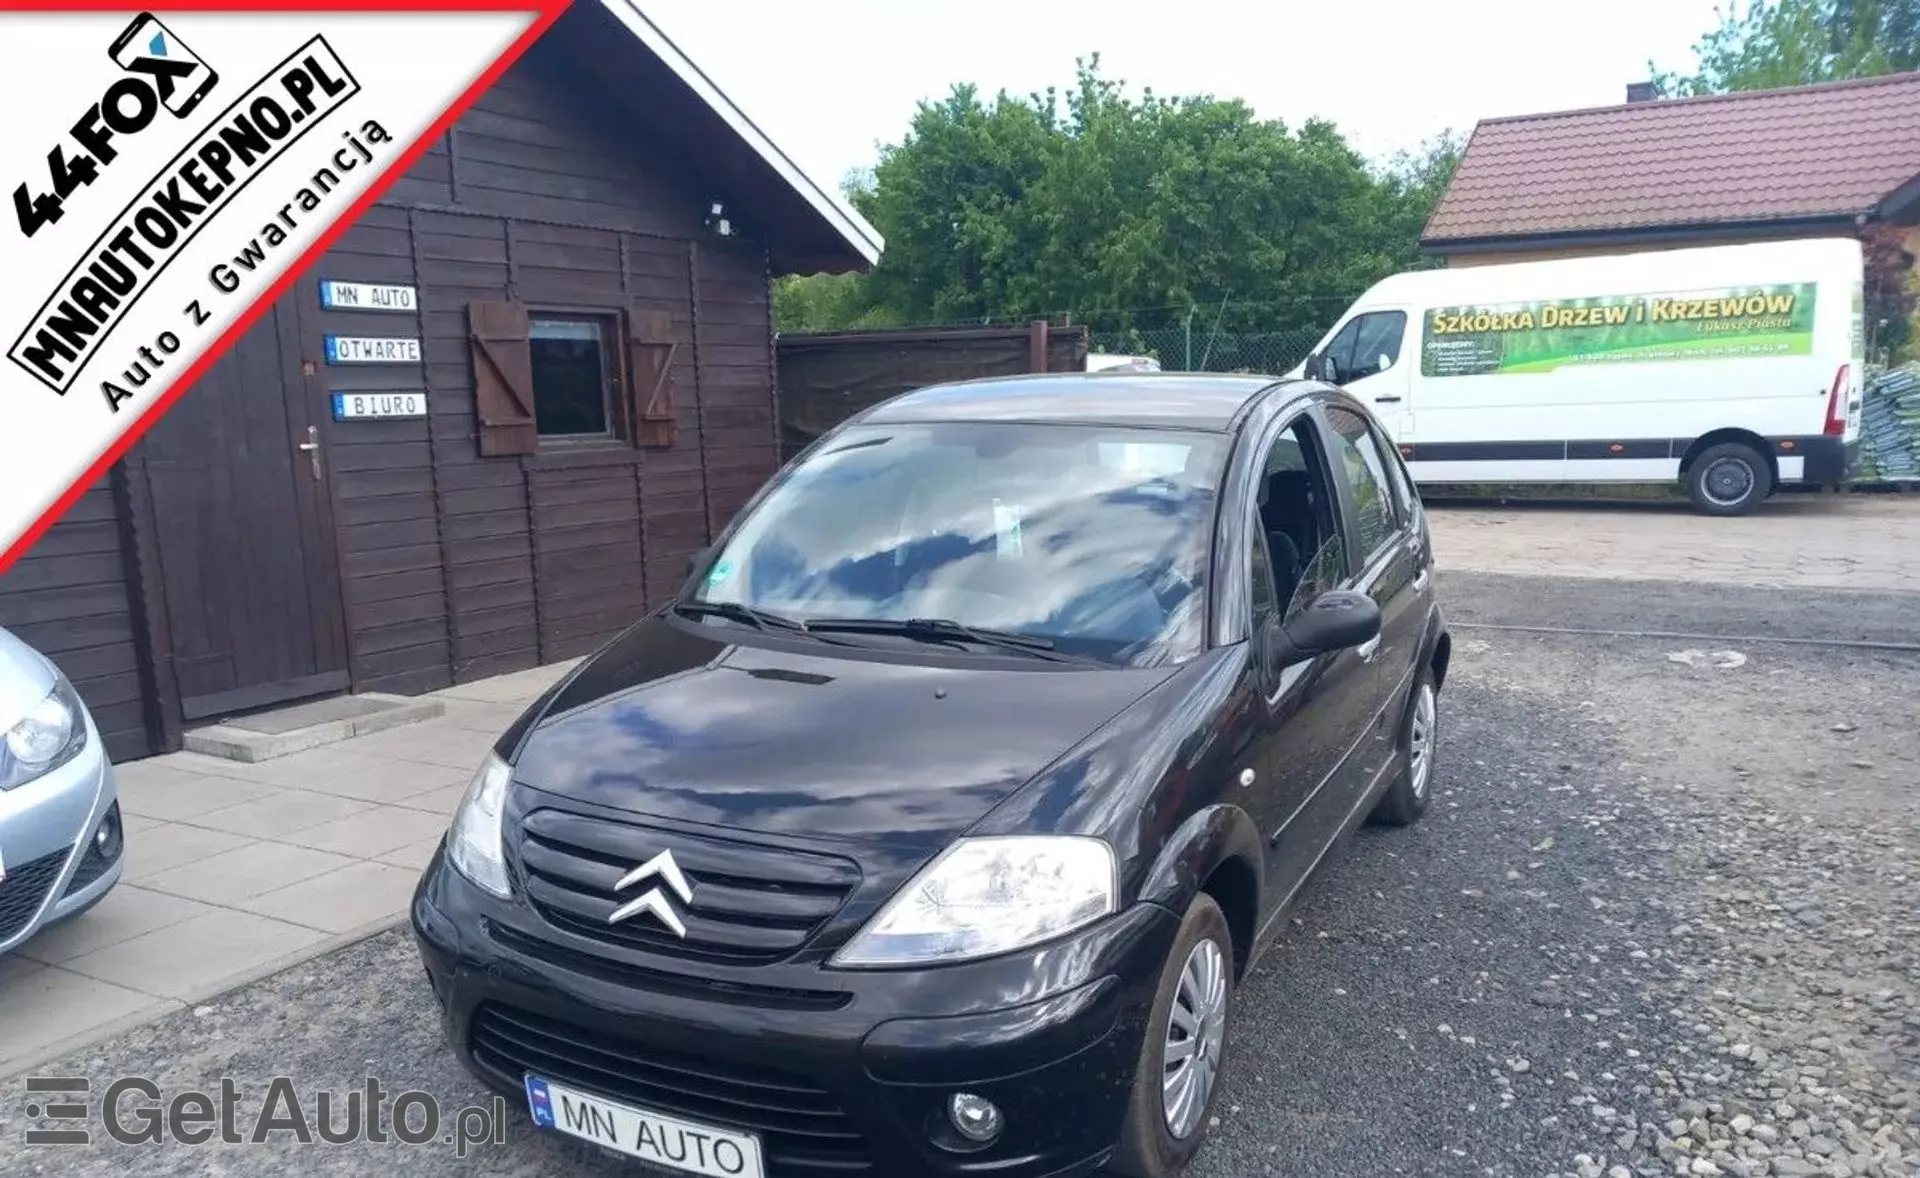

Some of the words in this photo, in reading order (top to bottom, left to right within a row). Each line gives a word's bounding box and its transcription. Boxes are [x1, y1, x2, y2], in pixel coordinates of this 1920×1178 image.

[336, 286, 358, 304] MN
[371, 288, 410, 307] AUTO
[1433, 309, 1534, 335] SZKÓŁKA
[1541, 300, 1629, 328] DRZEW
[1653, 290, 1793, 321] KRZEWÓW
[339, 340, 418, 360] OTWARTE
[354, 397, 416, 414] BIURO
[561, 1095, 617, 1143] MN
[636, 1120, 744, 1174] AUTO
